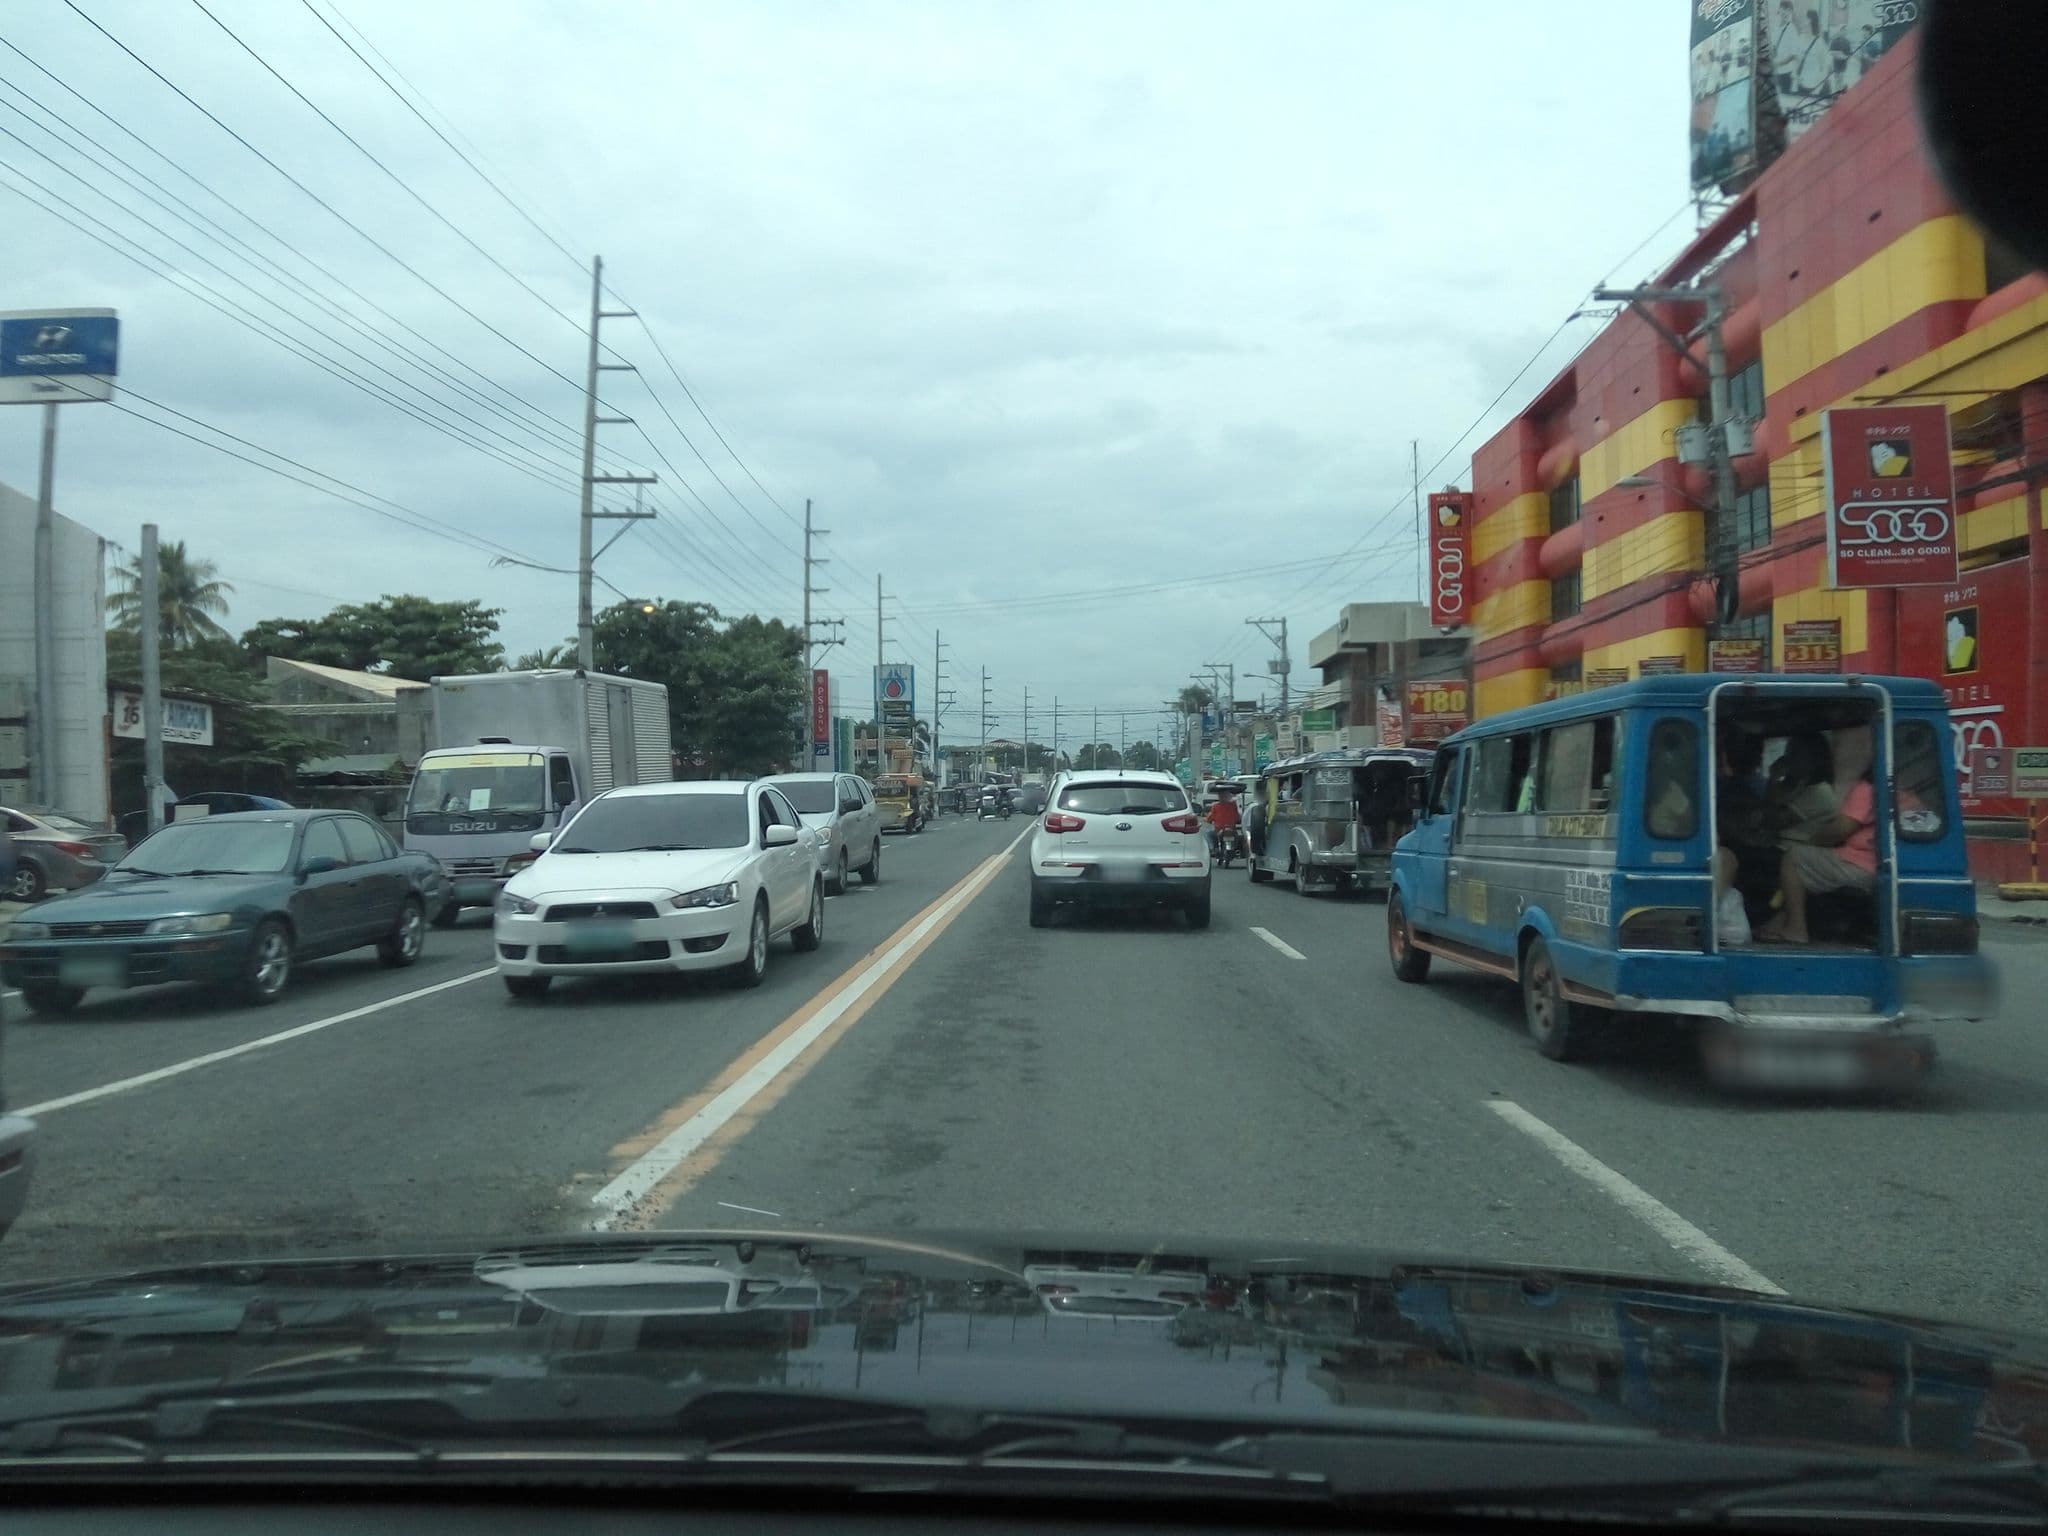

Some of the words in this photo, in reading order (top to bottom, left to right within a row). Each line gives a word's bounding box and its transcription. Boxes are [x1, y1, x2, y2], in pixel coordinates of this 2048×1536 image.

[1852, 486, 1932, 498] HOTEL
[1839, 498, 1949, 545] SOGO
[1840, 549, 1854, 558] SO
[1437, 537, 1463, 614] SOGO
[449, 822, 497, 832] ISUZU
